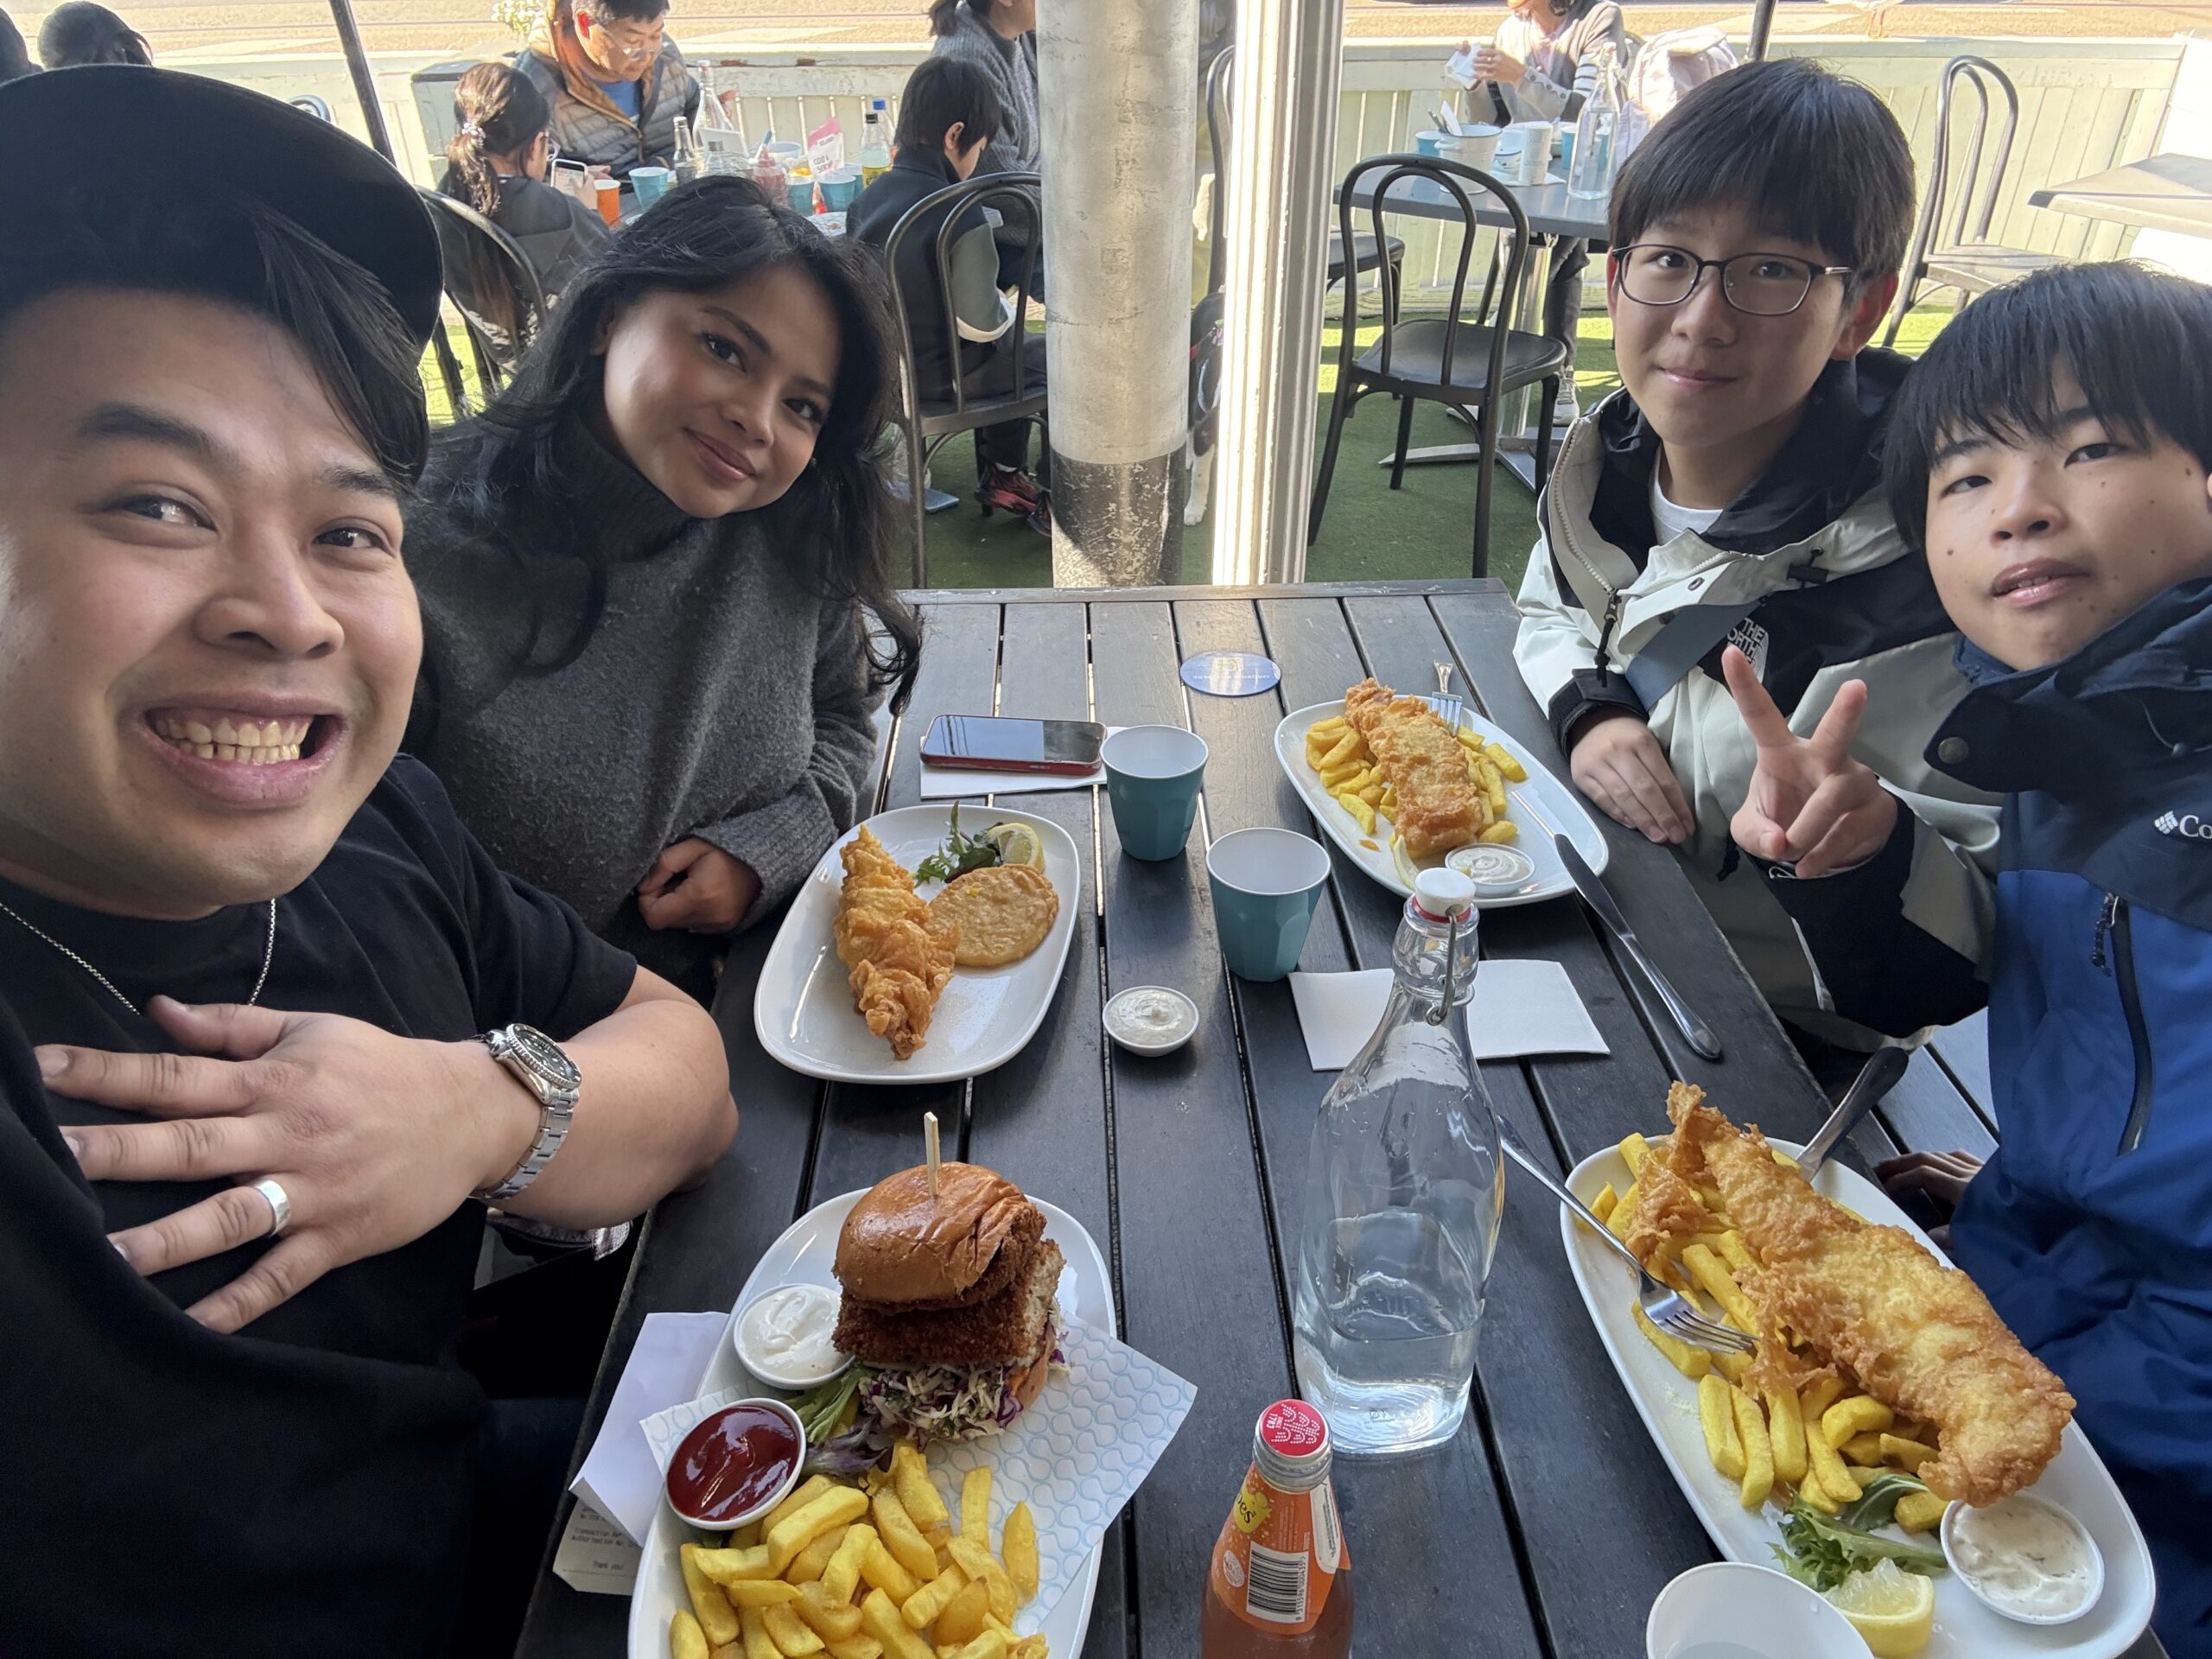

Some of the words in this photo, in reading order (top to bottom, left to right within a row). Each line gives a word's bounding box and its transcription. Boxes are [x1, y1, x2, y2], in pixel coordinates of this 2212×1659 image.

[1742, 618, 1765, 642] THE
[1727, 628, 1758, 658] ORTH
[2179, 814, 2212, 839] Co
